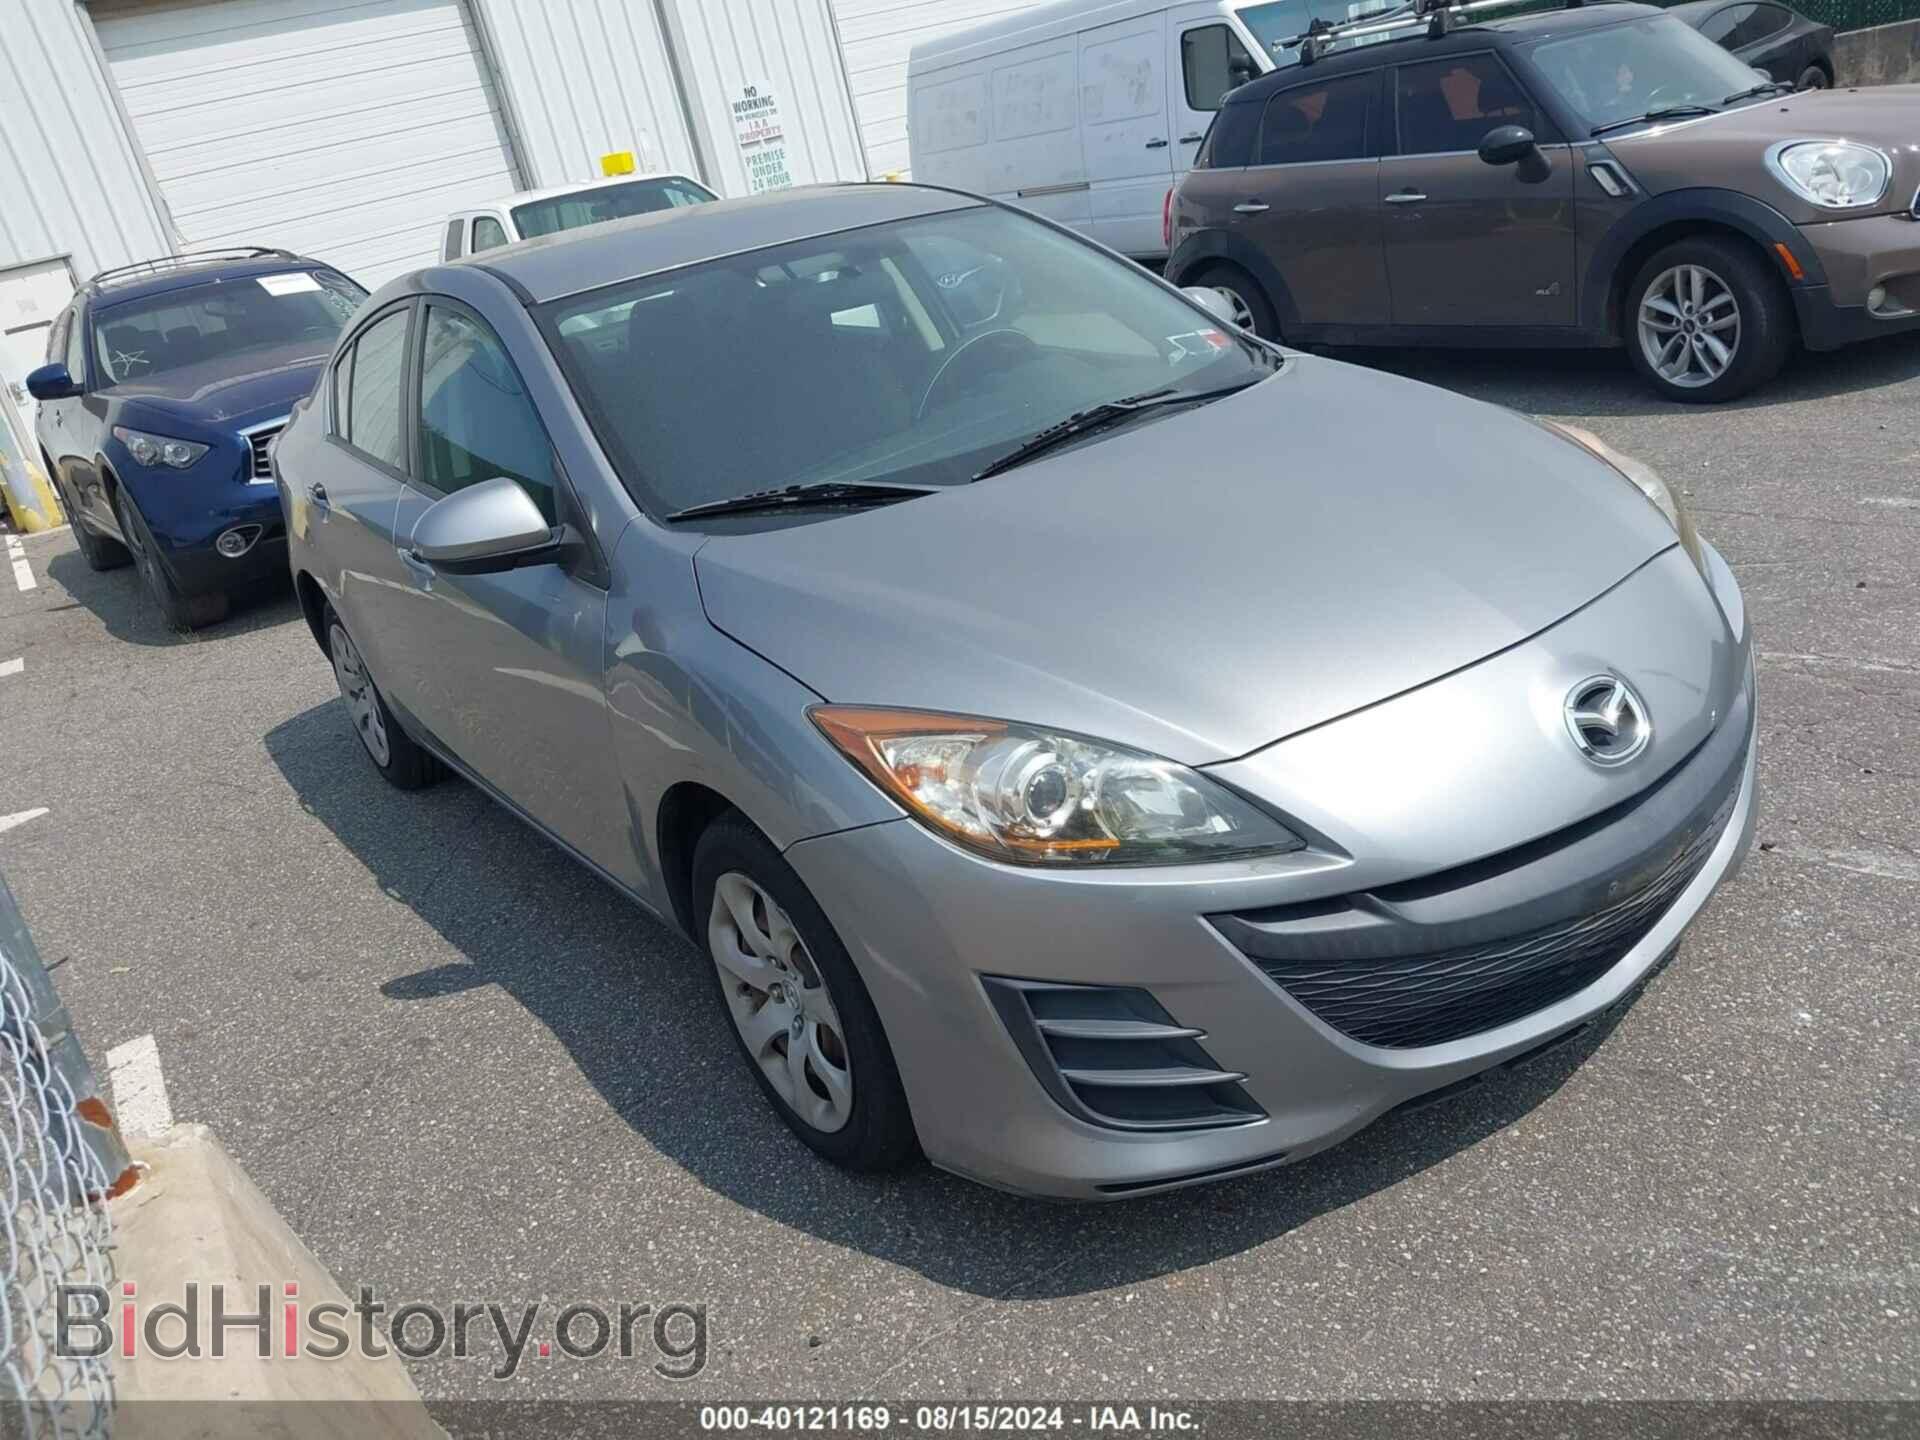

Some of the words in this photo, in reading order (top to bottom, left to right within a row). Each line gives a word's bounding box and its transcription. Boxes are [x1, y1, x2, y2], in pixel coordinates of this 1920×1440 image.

[744, 86, 757, 98] NO
[733, 95, 775, 113] WORKING
[740, 126, 782, 141] PROPERTY
[746, 149, 785, 167] PREMISE
[752, 161, 784, 178] UNDER
[752, 179, 764, 191] 24
[767, 171, 791, 187] HOUR
